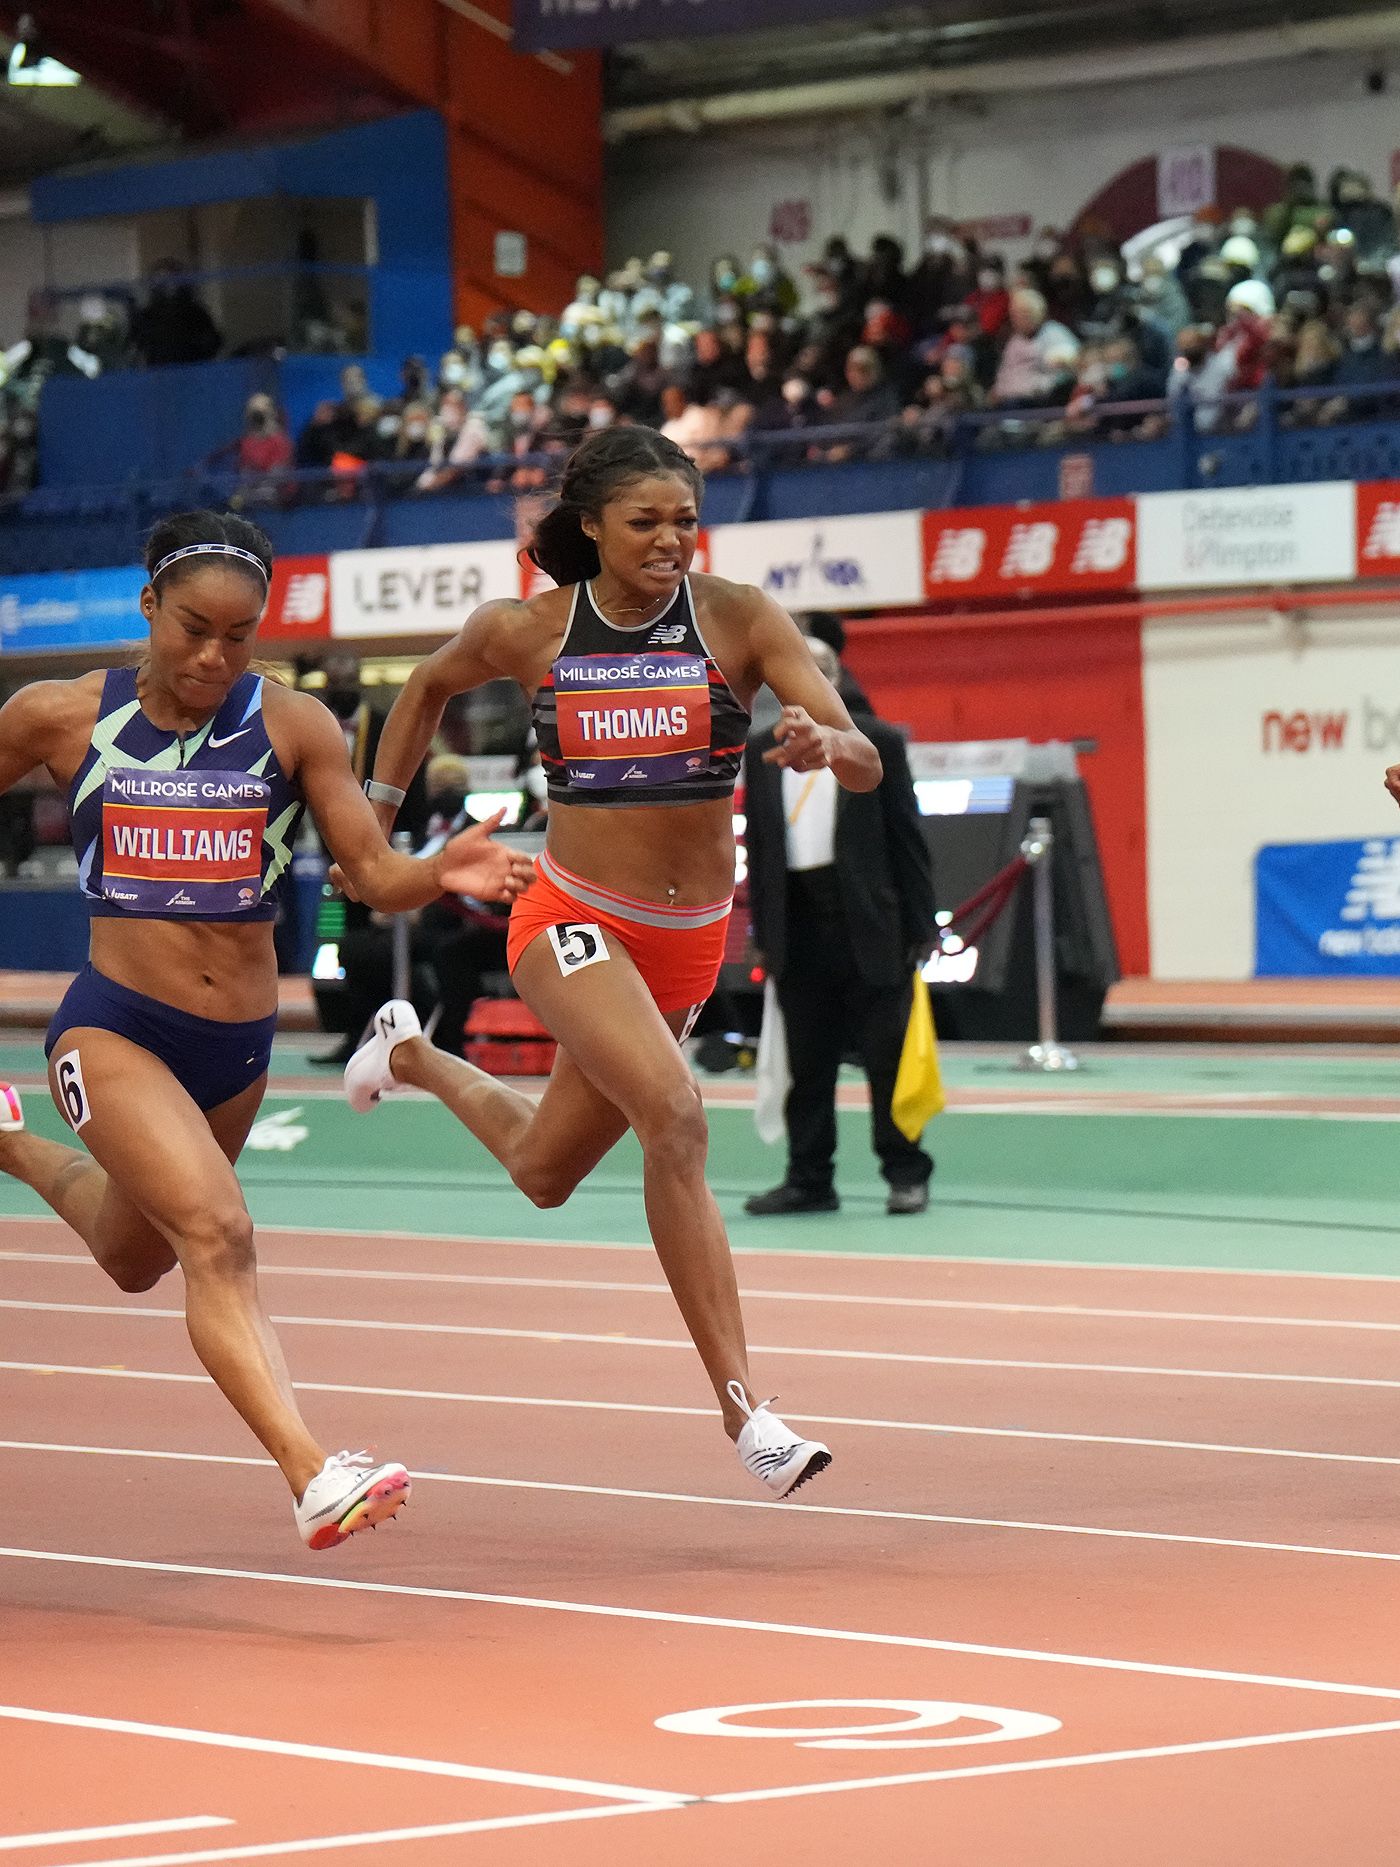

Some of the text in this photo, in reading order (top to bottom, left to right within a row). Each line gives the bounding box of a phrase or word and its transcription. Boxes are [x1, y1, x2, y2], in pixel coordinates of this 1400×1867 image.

[354, 566, 483, 611] LEVER
[559, 665, 701, 682] MILLROSE GAMES
[577, 706, 688, 740] THOMAS
[1262, 709, 1348, 753] new
[111, 779, 265, 798] MILLROSE GAMES
[112, 825, 253, 862] WILLIAMS
[114, 892, 140, 901] USATF
[555, 922, 597, 966] 5
[1319, 930, 1362, 956] new
[60, 1061, 84, 1125] 6
[653, 1699, 1063, 1750] 6
